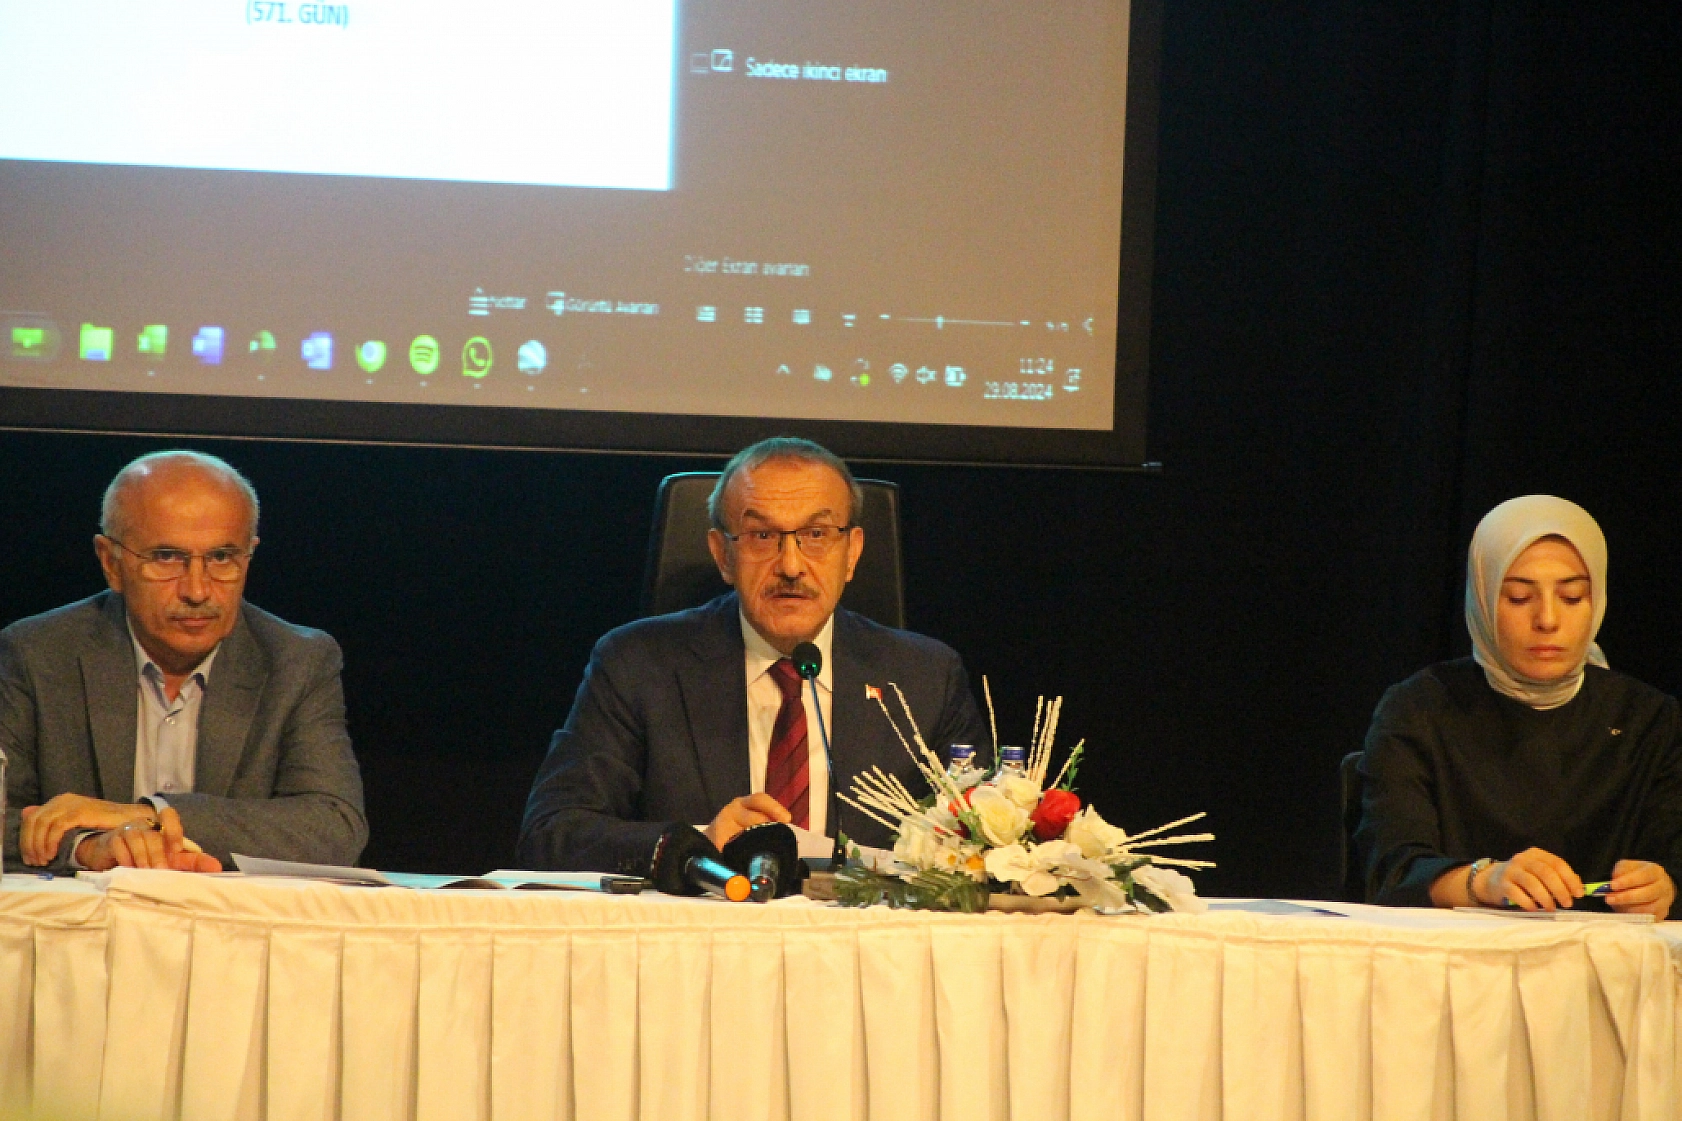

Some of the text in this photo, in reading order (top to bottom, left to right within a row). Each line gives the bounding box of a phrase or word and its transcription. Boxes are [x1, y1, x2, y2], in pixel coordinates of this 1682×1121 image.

[246, 0, 349, 30] (571. GÜN)
[746, 56, 799, 79] Sadece
[844, 63, 888, 83] ekran
[1019, 357, 1054, 375] 11:24
[983, 380, 1054, 400] 29.08.2024
